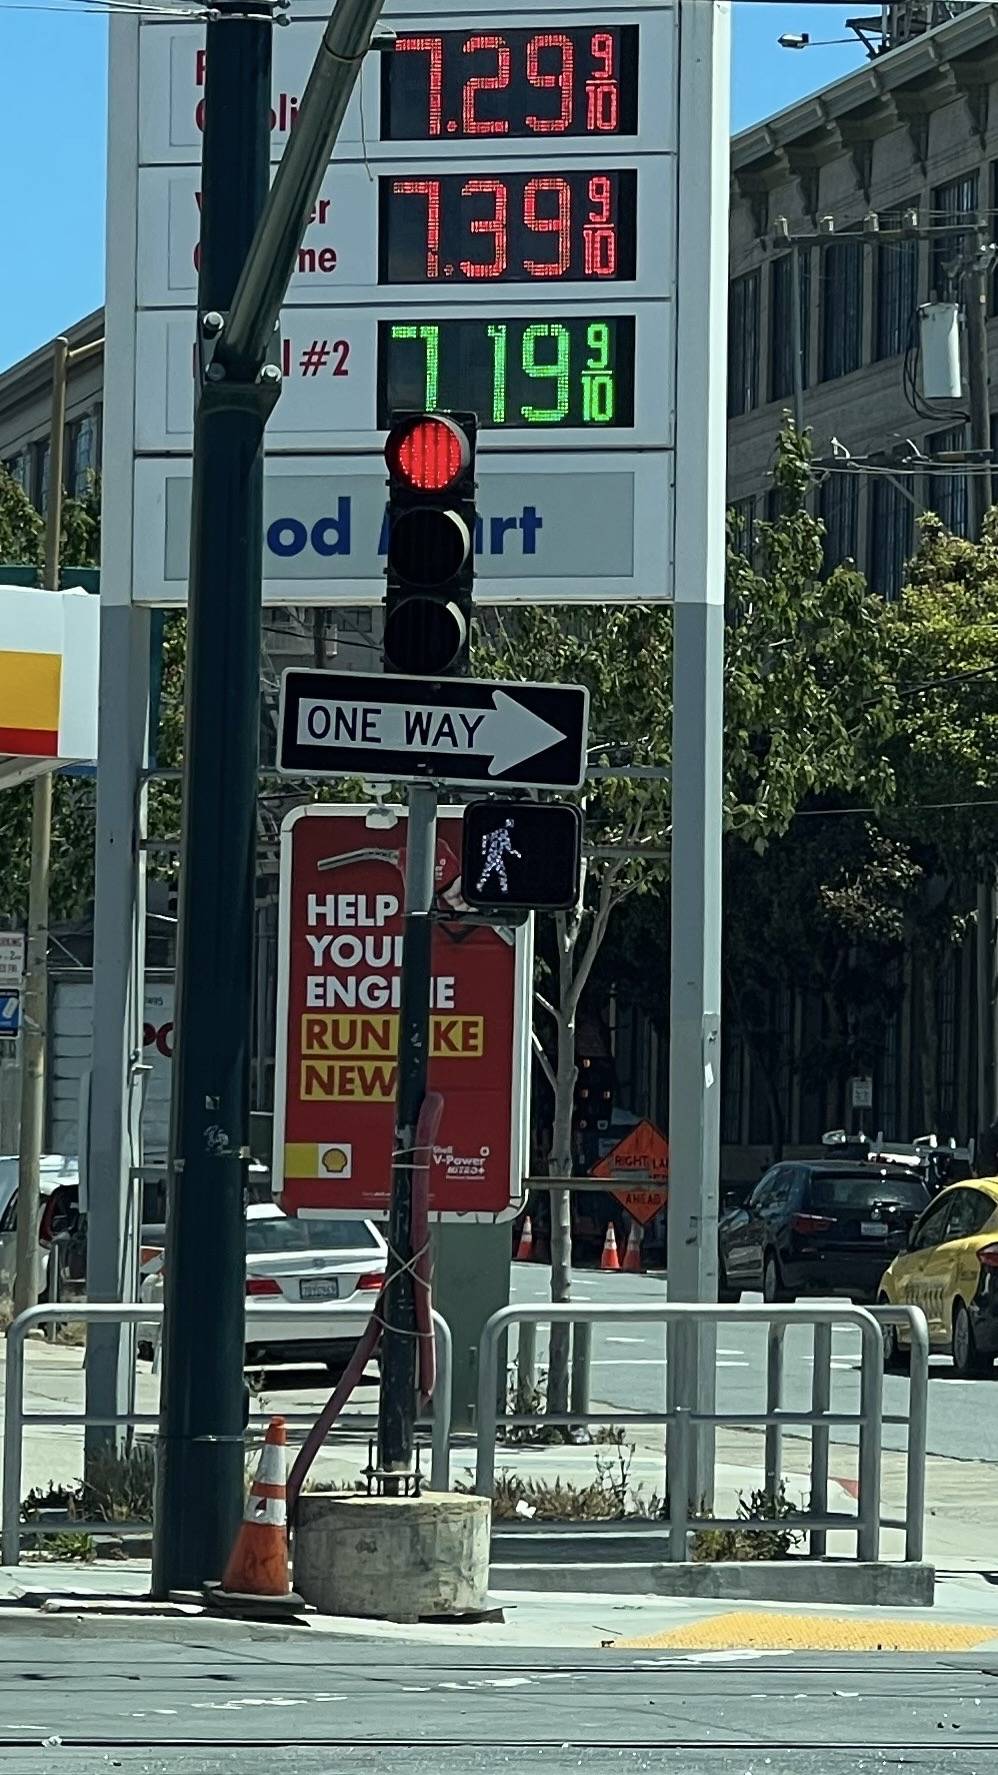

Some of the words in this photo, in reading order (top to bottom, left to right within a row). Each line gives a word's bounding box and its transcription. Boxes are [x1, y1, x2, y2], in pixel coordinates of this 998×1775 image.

[395, 34, 573, 135] 7.29
[393, 178, 571, 277] 7.39
[299, 340, 350, 376] #2
[392, 324, 569, 423] 719
[307, 705, 382, 743] ONE
[404, 710, 486, 749] WAY
[307, 894, 399, 927] HELP
[306, 975, 455, 1009] ENGIE
[306, 1019, 391, 1051] RUN
[305, 1065, 398, 1097] NEW
[615, 1155, 649, 1168] RIGHT
[652, 1158, 669, 1170] LA
